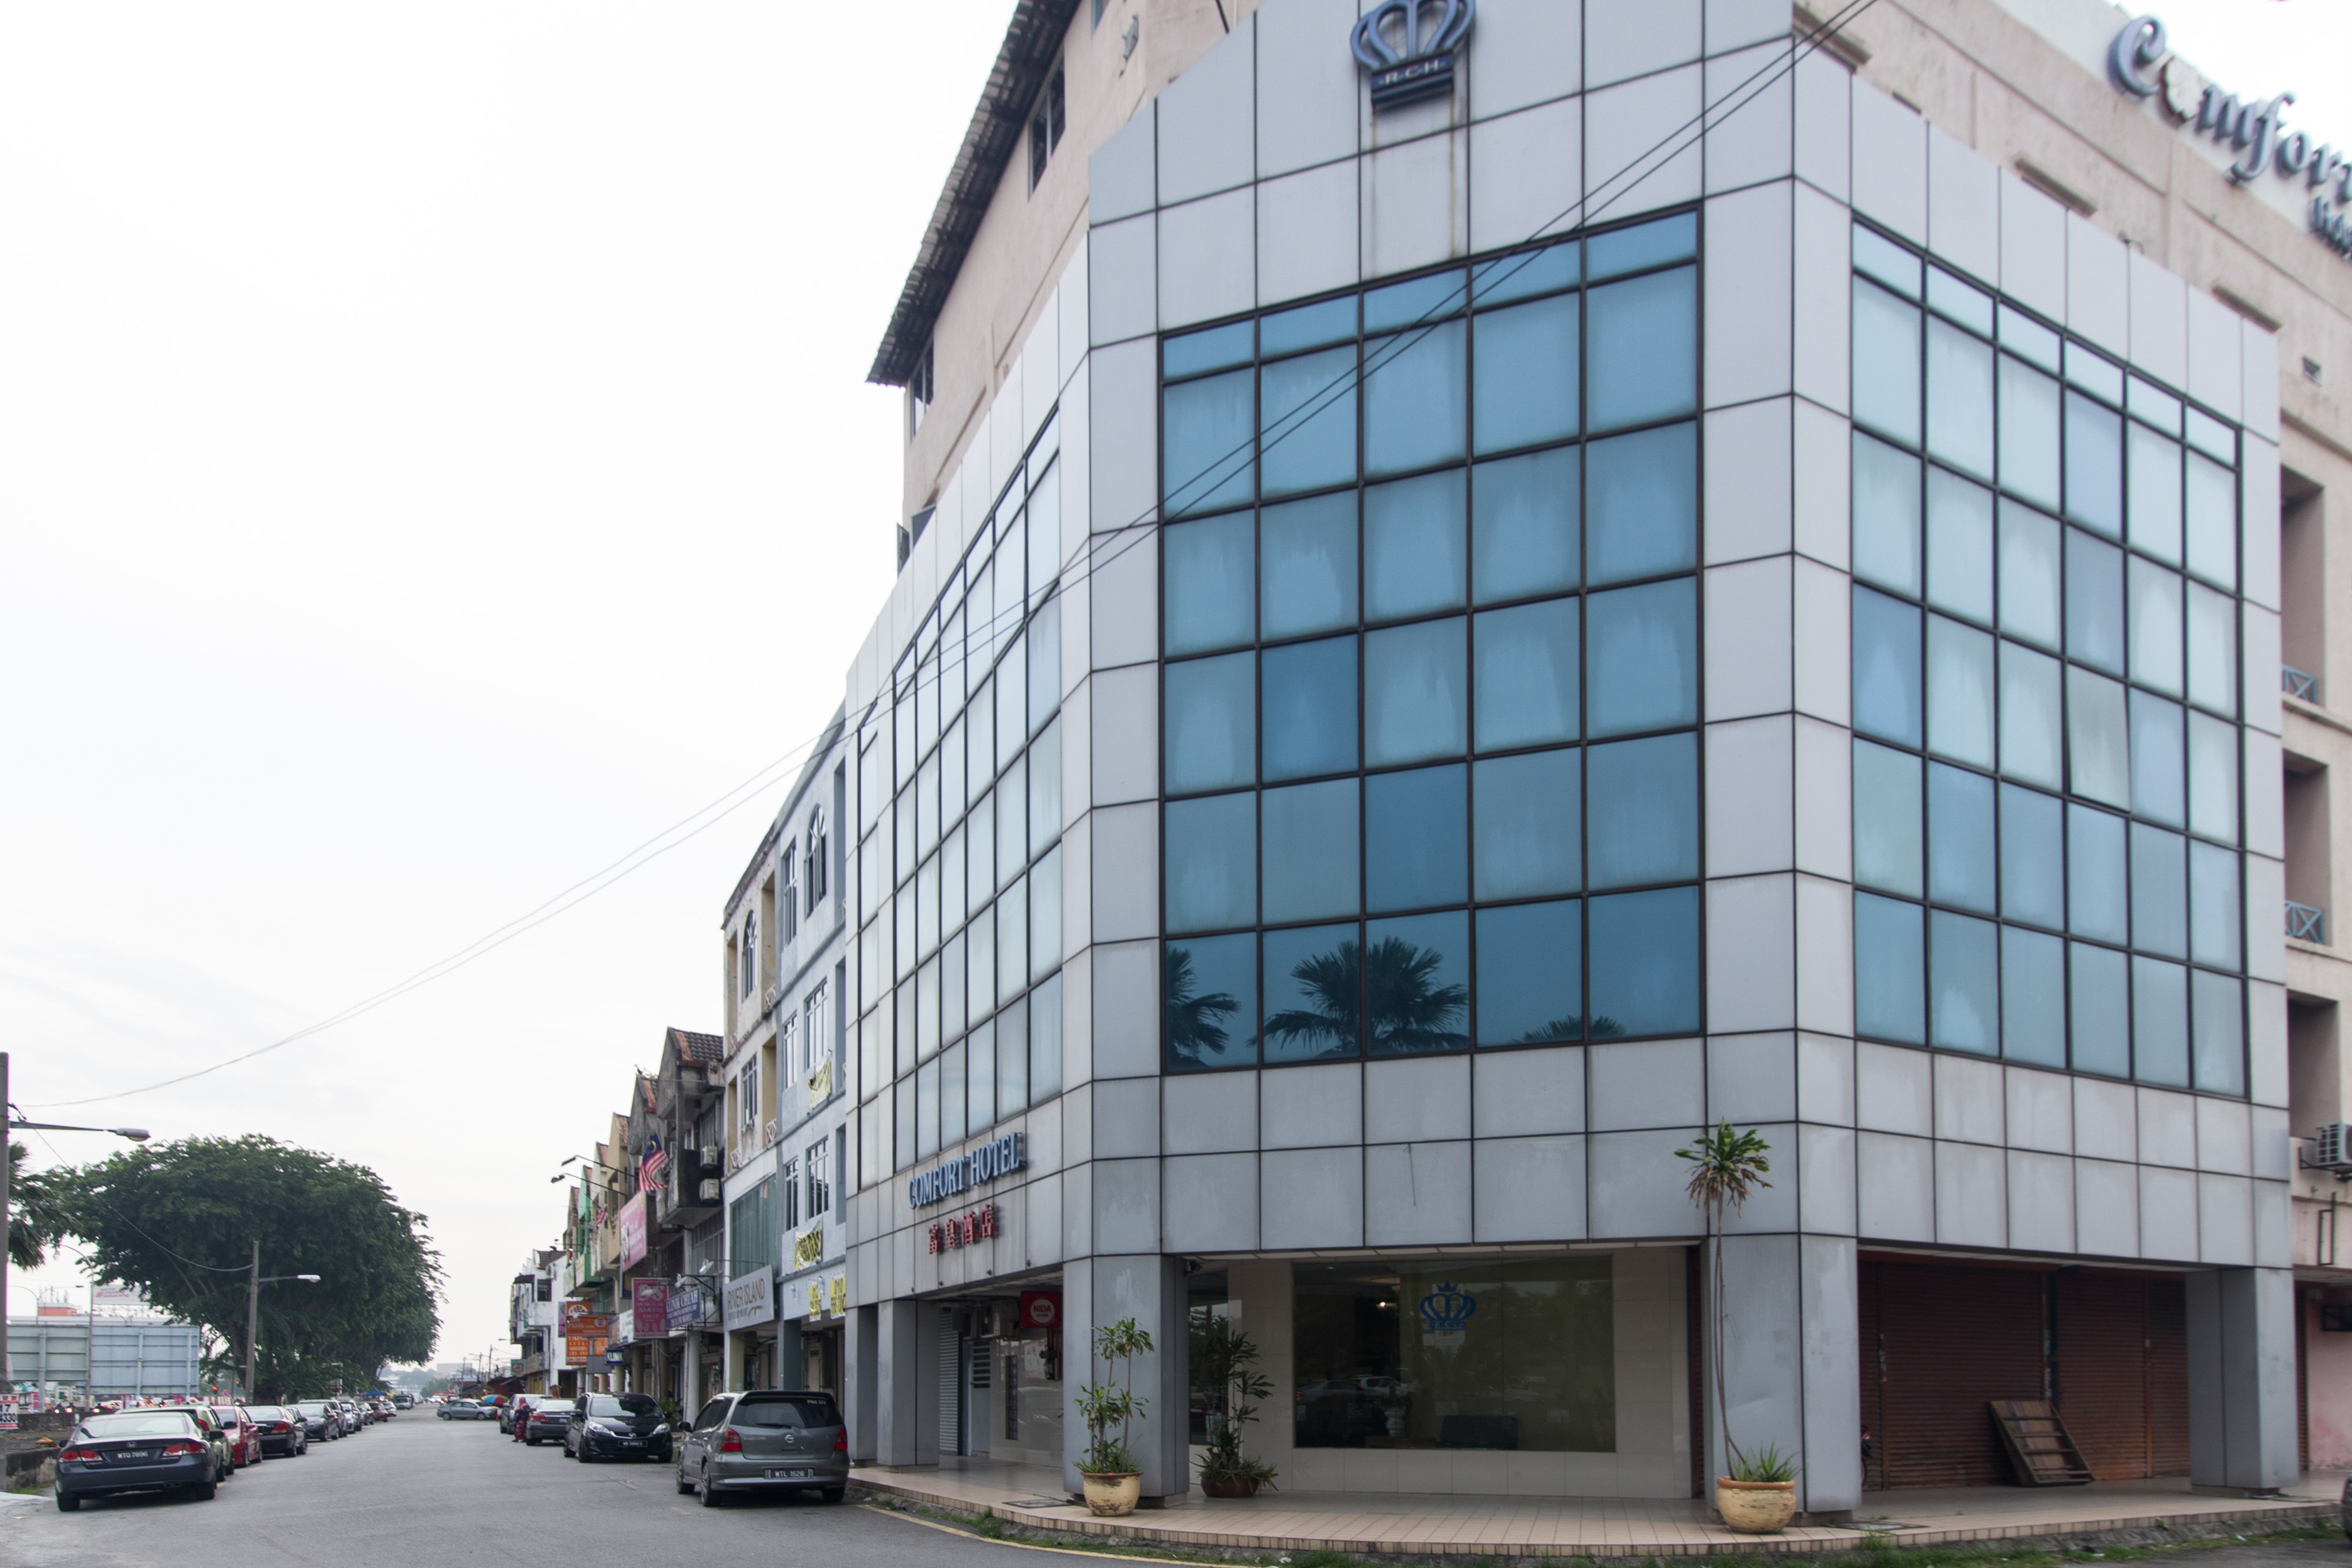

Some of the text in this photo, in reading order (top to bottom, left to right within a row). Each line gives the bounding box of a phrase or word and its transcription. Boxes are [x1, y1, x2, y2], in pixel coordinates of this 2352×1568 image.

[1383, 59, 1441, 86] RCH
[908, 1131, 1022, 1209] COMFORT HOTEL
[928, 1203, 996, 1254] 富皇酒店
[727, 1277, 765, 1311] RIVER ISLAND
[1033, 1304, 1052, 1312] NIDA
[607, 1352, 623, 1361] KLINIK
[774, 1470, 805, 1478] WTL 1528
